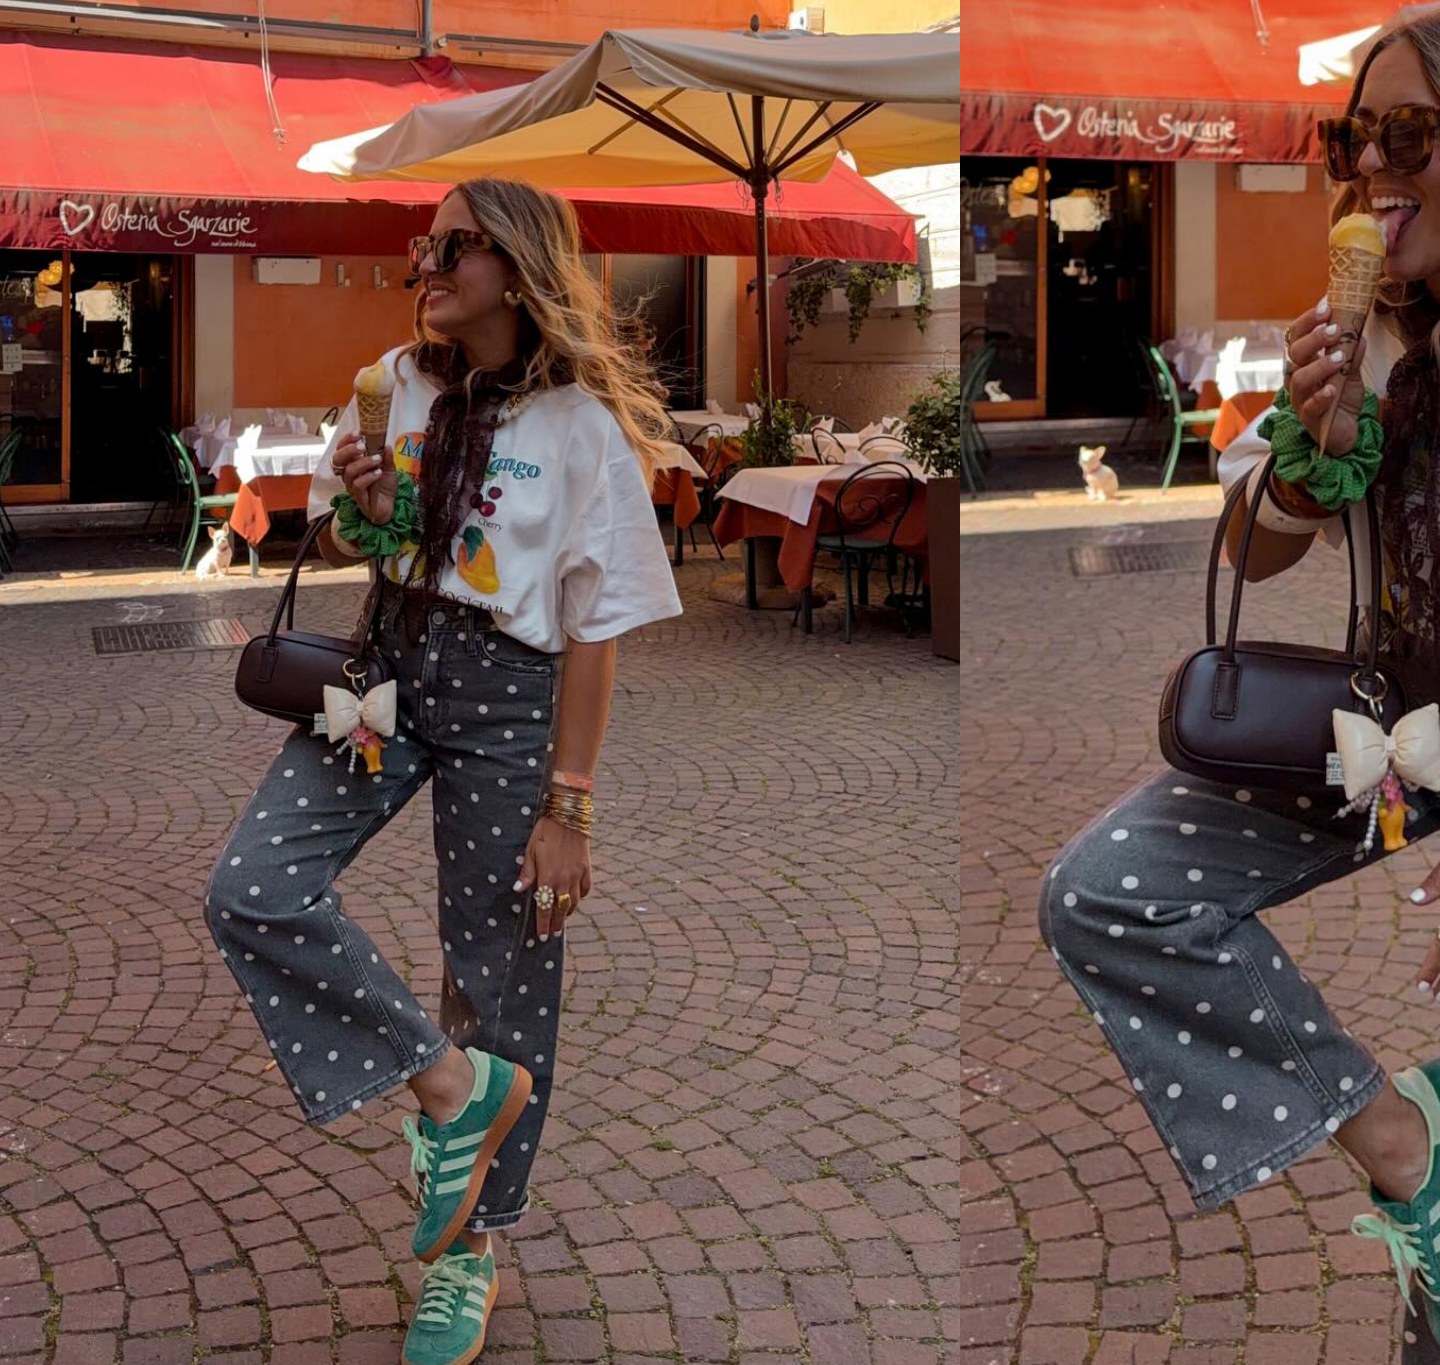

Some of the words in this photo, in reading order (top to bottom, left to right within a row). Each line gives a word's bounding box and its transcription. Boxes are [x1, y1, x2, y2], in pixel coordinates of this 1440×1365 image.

[1077, 107, 1158, 143] Osteria
[102, 203, 176, 237] Osteria
[167, 209, 258, 247] Sgarzarie
[488, 451, 542, 480] ango
[478, 517, 503, 531] Cherry
